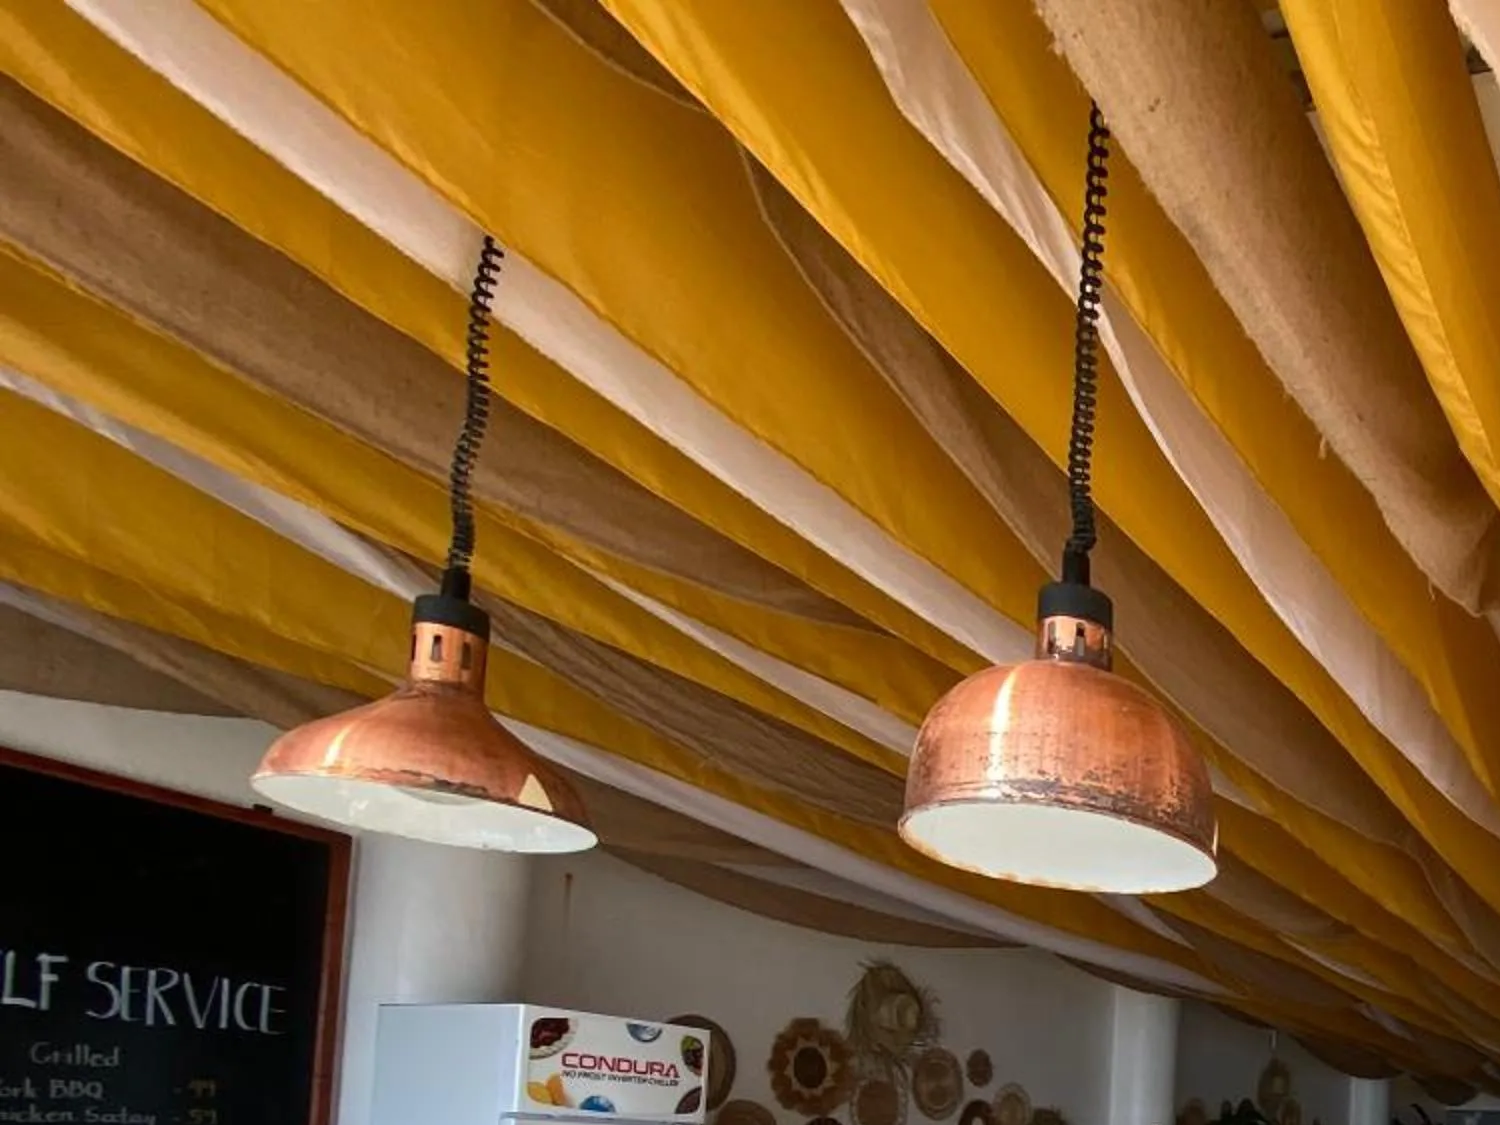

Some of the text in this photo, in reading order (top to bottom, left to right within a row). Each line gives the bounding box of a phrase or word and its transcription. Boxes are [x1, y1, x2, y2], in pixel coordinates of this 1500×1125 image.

[0, 948, 288, 1036] LF SERVICE
[30, 1041, 120, 1067] Grilled
[562, 1053, 681, 1079] CONDURA
[0, 1077, 38, 1099] ork
[49, 1079, 105, 1101] BBQ
